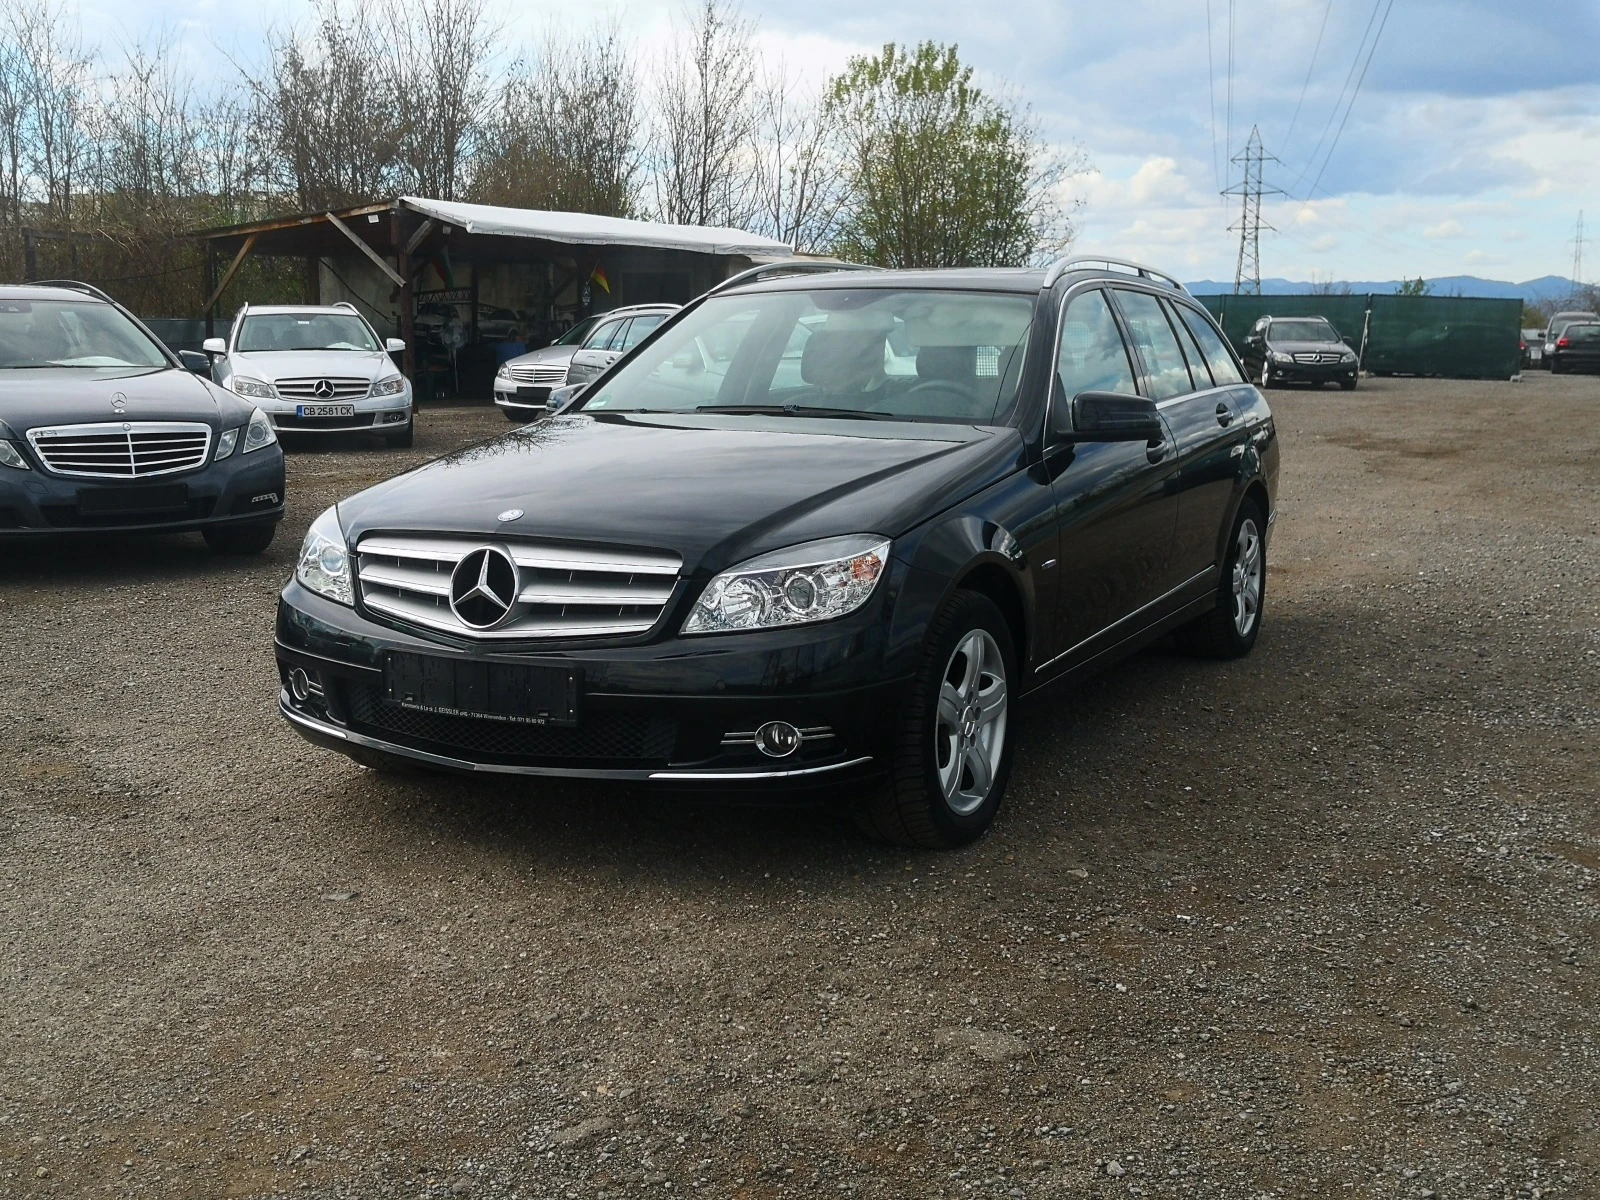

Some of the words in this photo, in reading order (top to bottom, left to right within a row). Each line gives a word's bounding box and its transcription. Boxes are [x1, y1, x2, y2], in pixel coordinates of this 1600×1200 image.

[303, 407, 316, 416] CB
[317, 406, 339, 416] 2581
[340, 406, 352, 416] CK
[438, 707, 459, 716] GEISSLER
